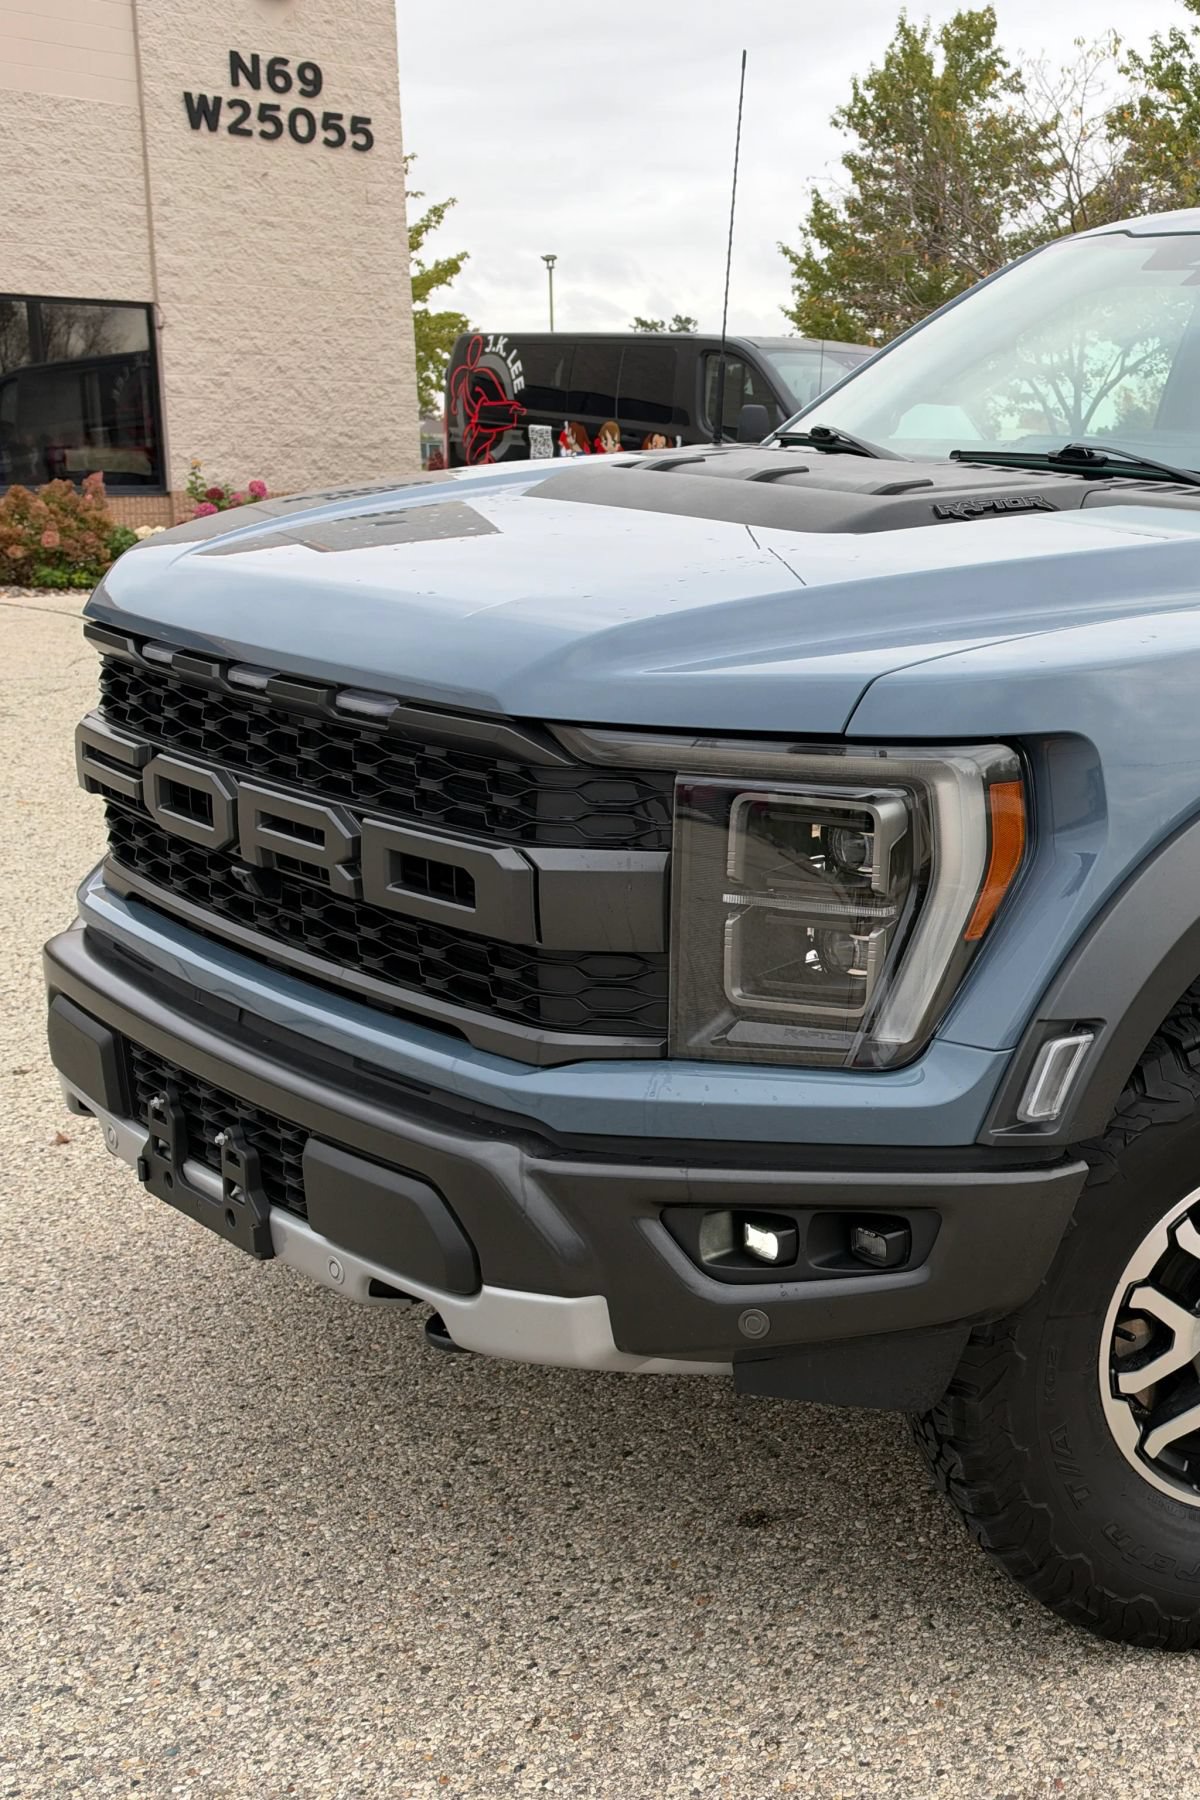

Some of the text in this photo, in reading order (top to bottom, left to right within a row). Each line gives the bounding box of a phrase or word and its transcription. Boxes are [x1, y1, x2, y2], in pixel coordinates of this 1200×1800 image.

[228, 50, 323, 98] N69
[183, 91, 375, 152] W25055
[505, 349, 525, 394] LEE
[934, 495, 1057, 521] RAPTOR
[75, 715, 537, 945] FORD
